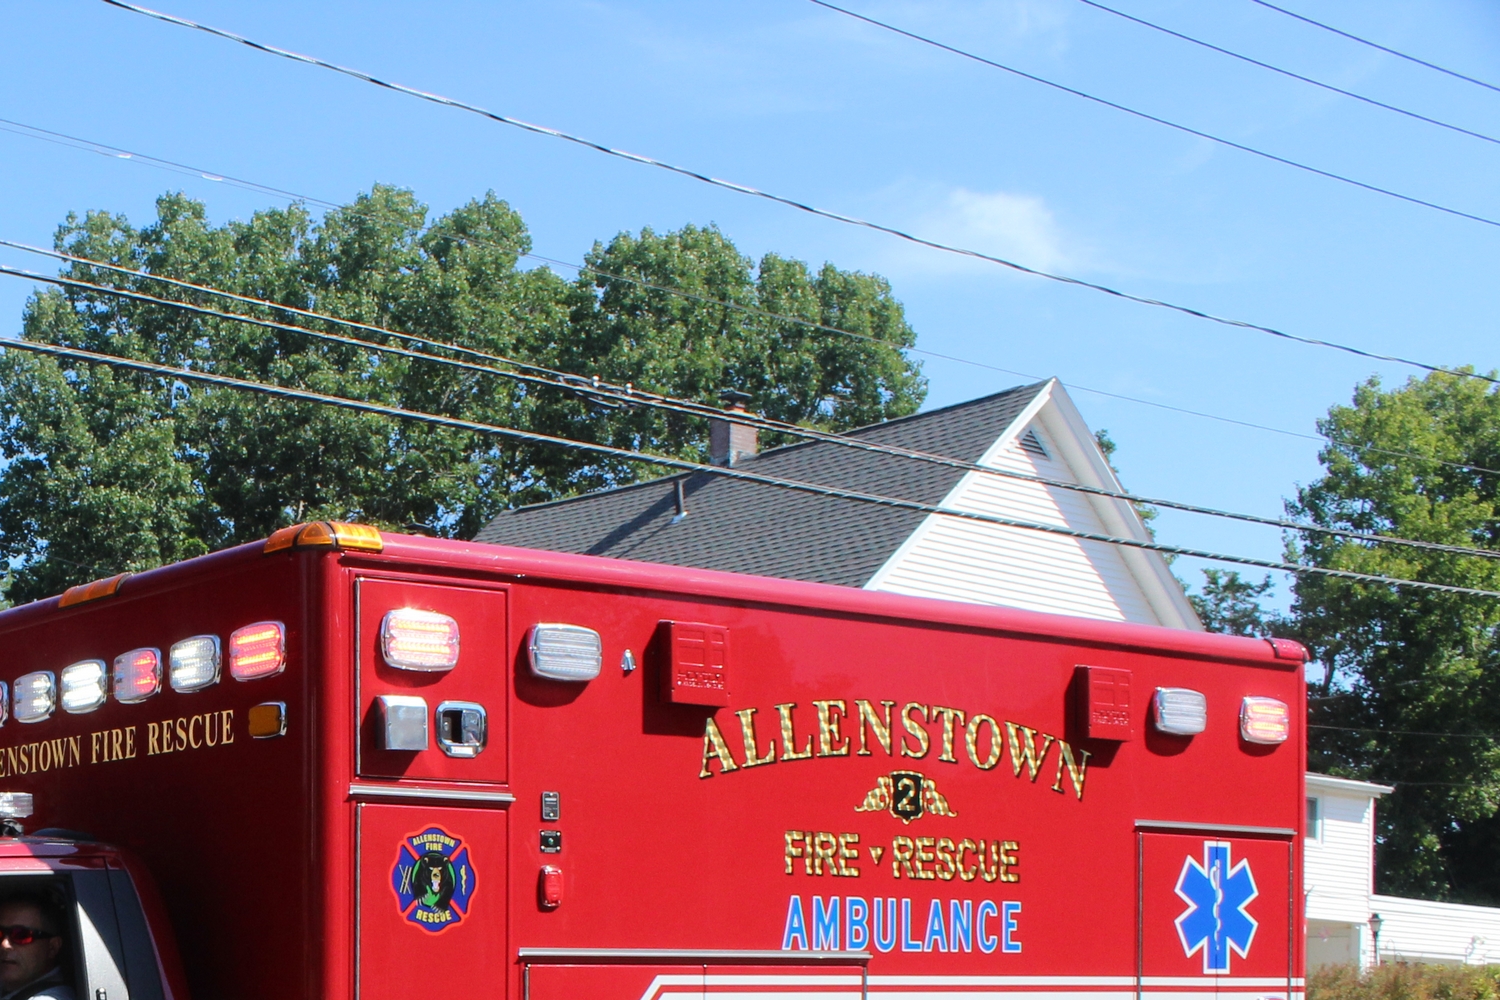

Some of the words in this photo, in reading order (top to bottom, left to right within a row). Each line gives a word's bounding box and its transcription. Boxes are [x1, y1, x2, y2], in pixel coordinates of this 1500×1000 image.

[91, 726, 137, 764] FIRE
[147, 709, 235, 756] RESCUE
[699, 699, 1092, 801] ALLENSTOWN
[897, 778, 915, 811] 2
[412, 833, 456, 848] ALLENSTOWN
[425, 842, 443, 851] FIRE
[784, 830, 859, 877] FIRE
[892, 836, 1020, 883] RESCUE
[415, 909, 452, 923] RESCUE
[782, 895, 1022, 953] AMBULANCE
